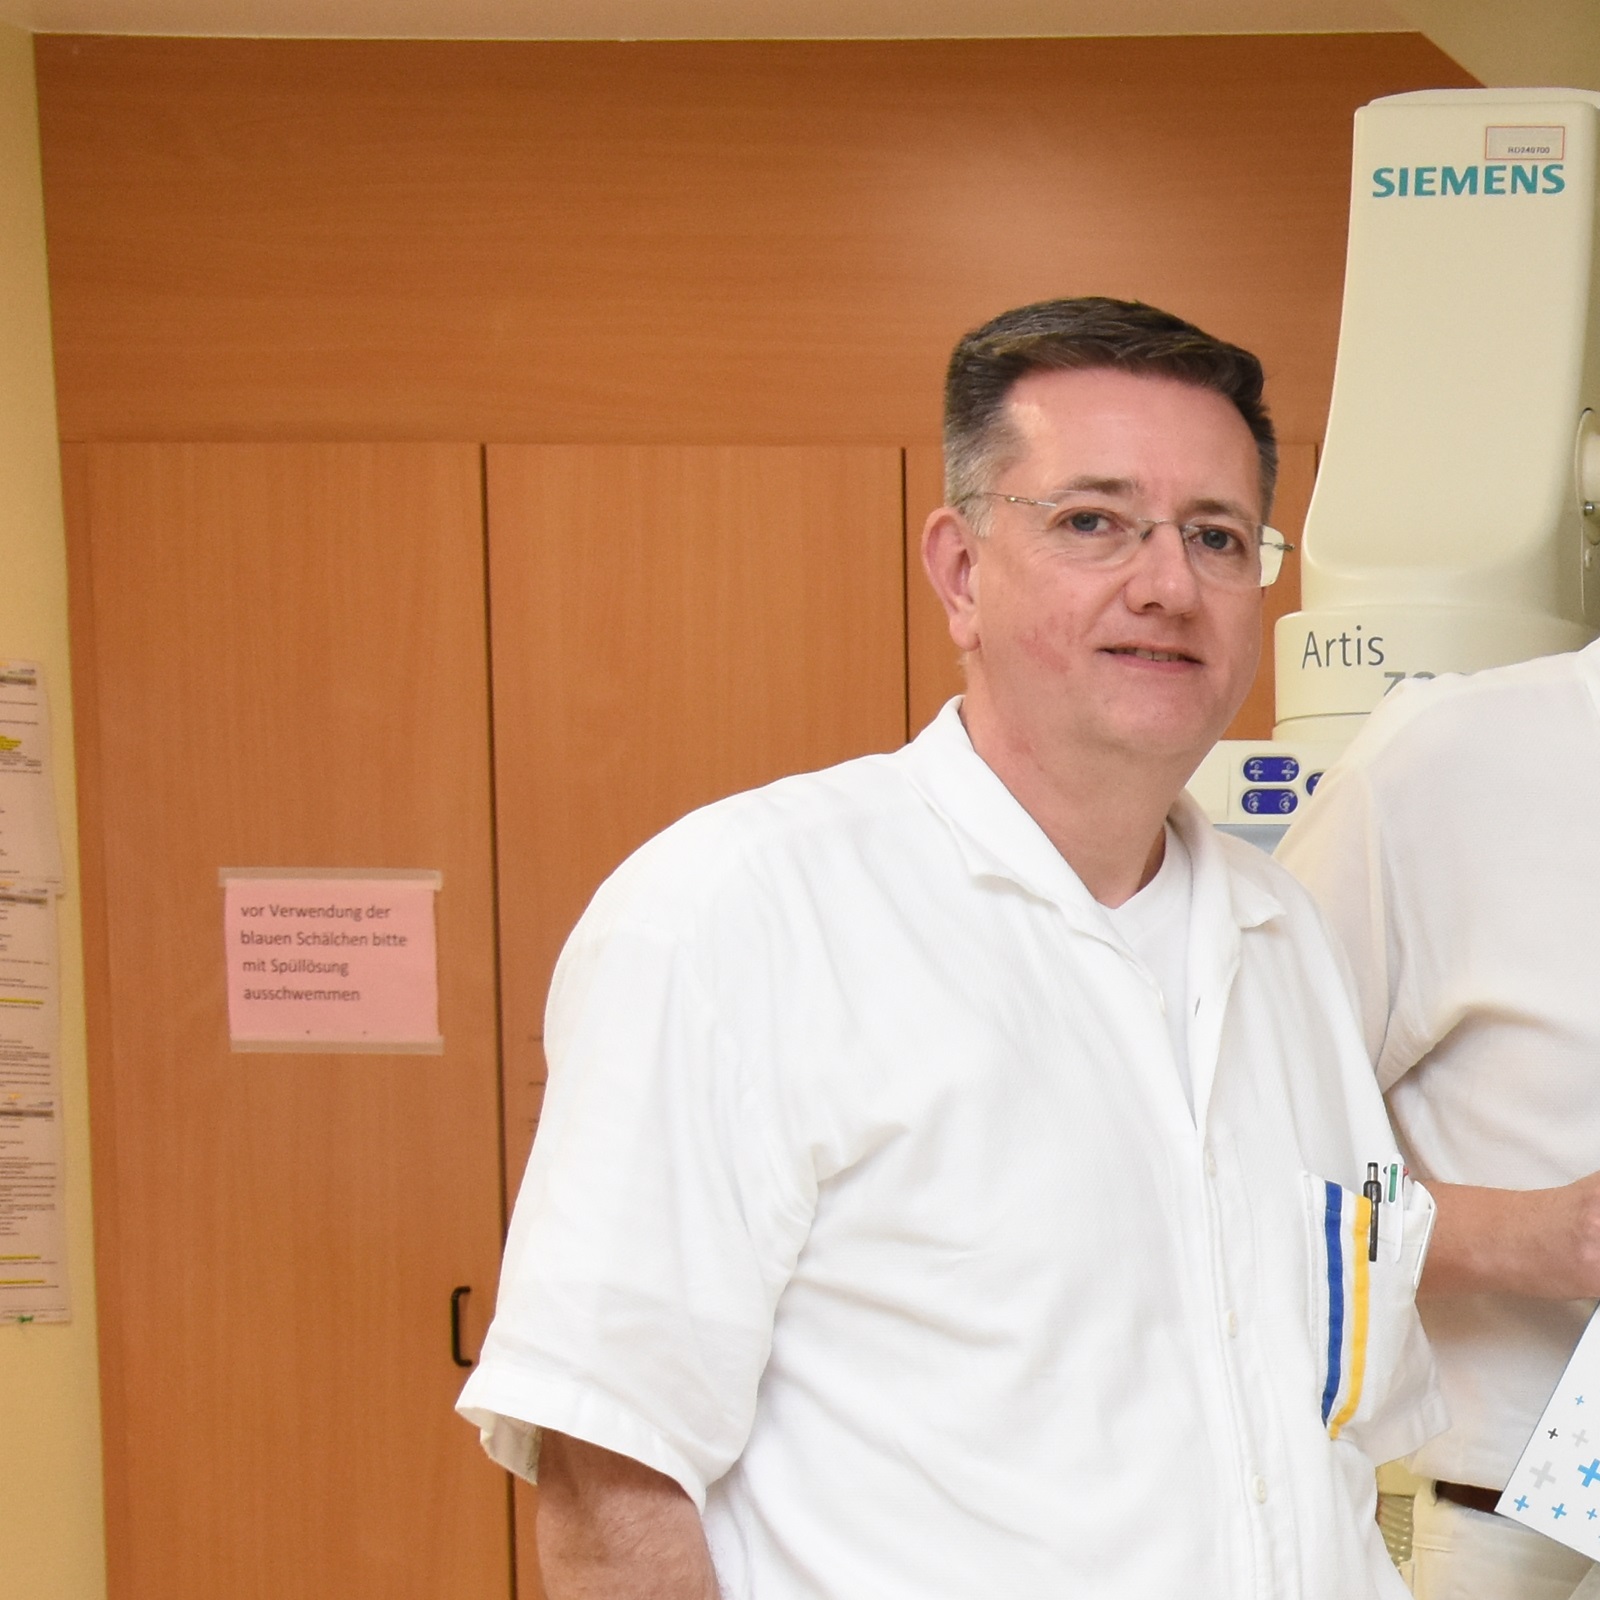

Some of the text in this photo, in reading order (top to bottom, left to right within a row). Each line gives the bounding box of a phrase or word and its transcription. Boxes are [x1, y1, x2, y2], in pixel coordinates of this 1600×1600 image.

[1372, 164, 1566, 198] SIEMENS
[1302, 625, 1384, 669] Artis
[240, 904, 391, 922] vor Verwendung der
[240, 931, 407, 947] blauen Schälchen bitte
[242, 959, 350, 977] mit Spüllösung
[243, 986, 360, 1001] ausschwemmen
